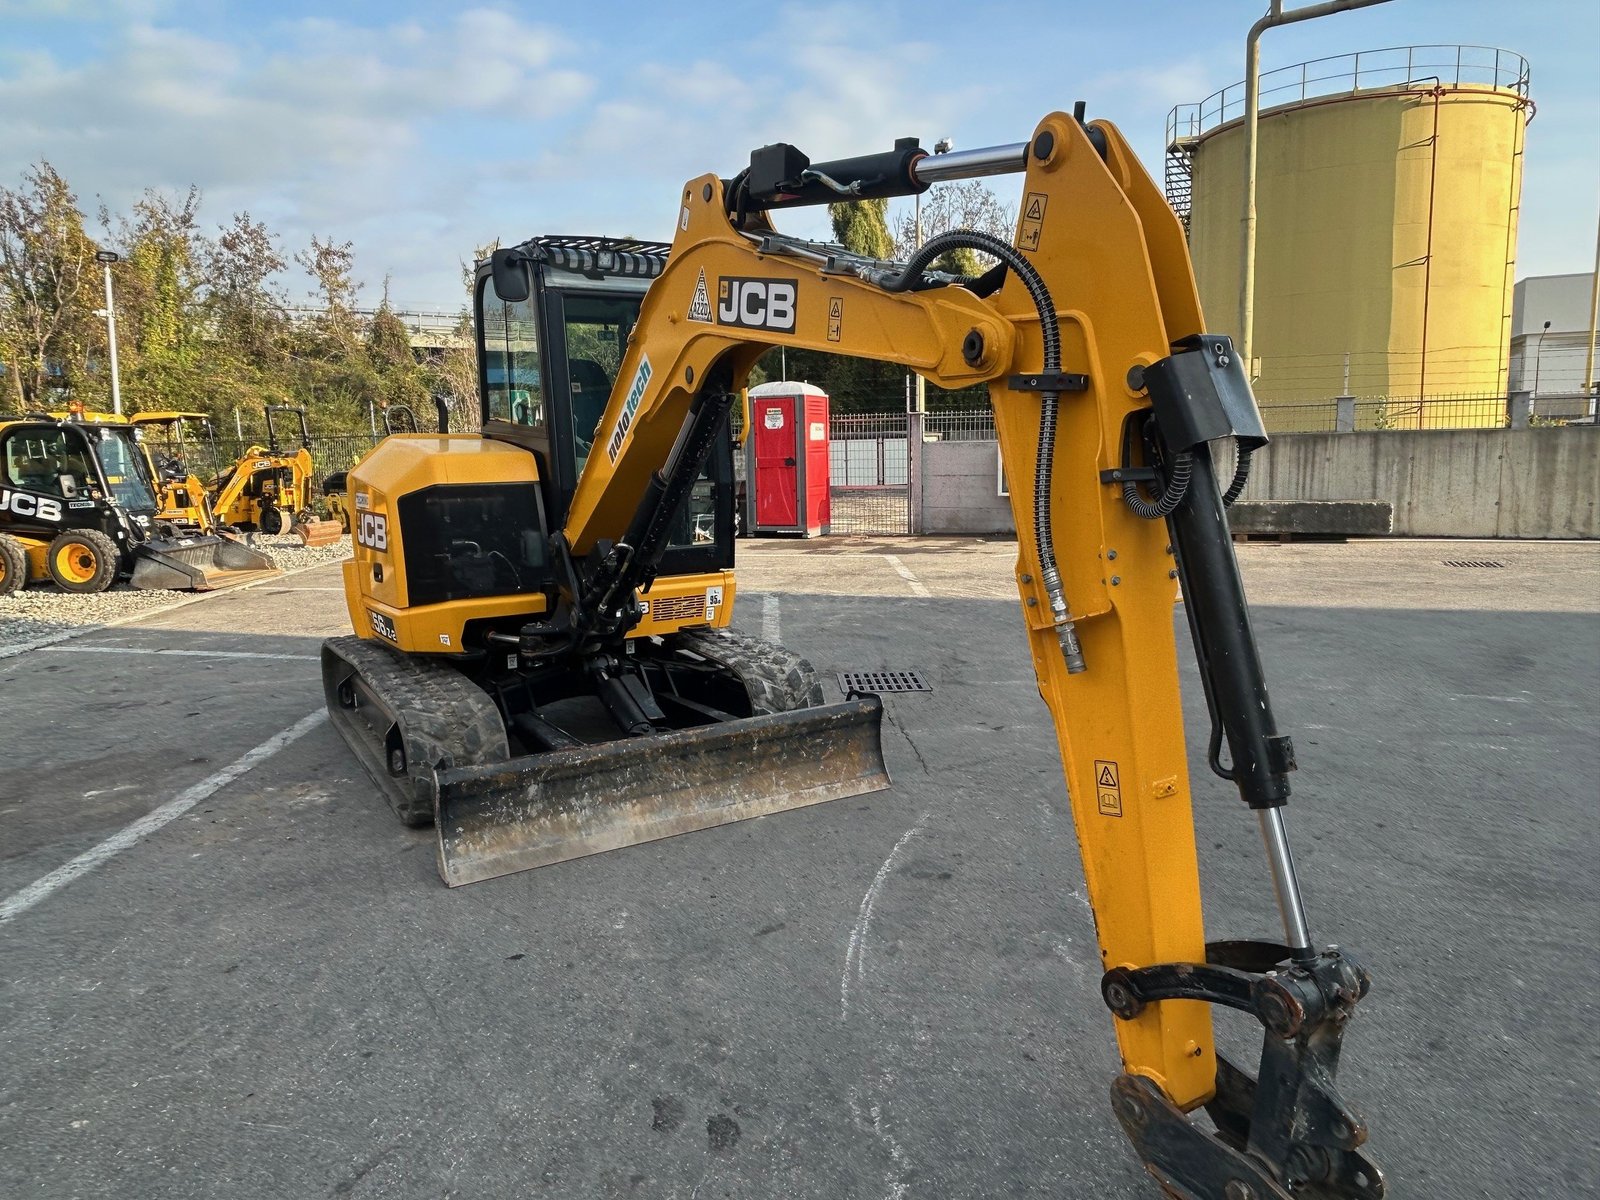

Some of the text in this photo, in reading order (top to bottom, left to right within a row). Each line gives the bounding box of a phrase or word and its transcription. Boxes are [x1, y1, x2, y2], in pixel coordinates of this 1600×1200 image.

[719, 281, 795, 329] JCB
[608, 360, 651, 464] nolotech
[252, 460, 271, 469] JCB
[357, 513, 387, 550] JCB
